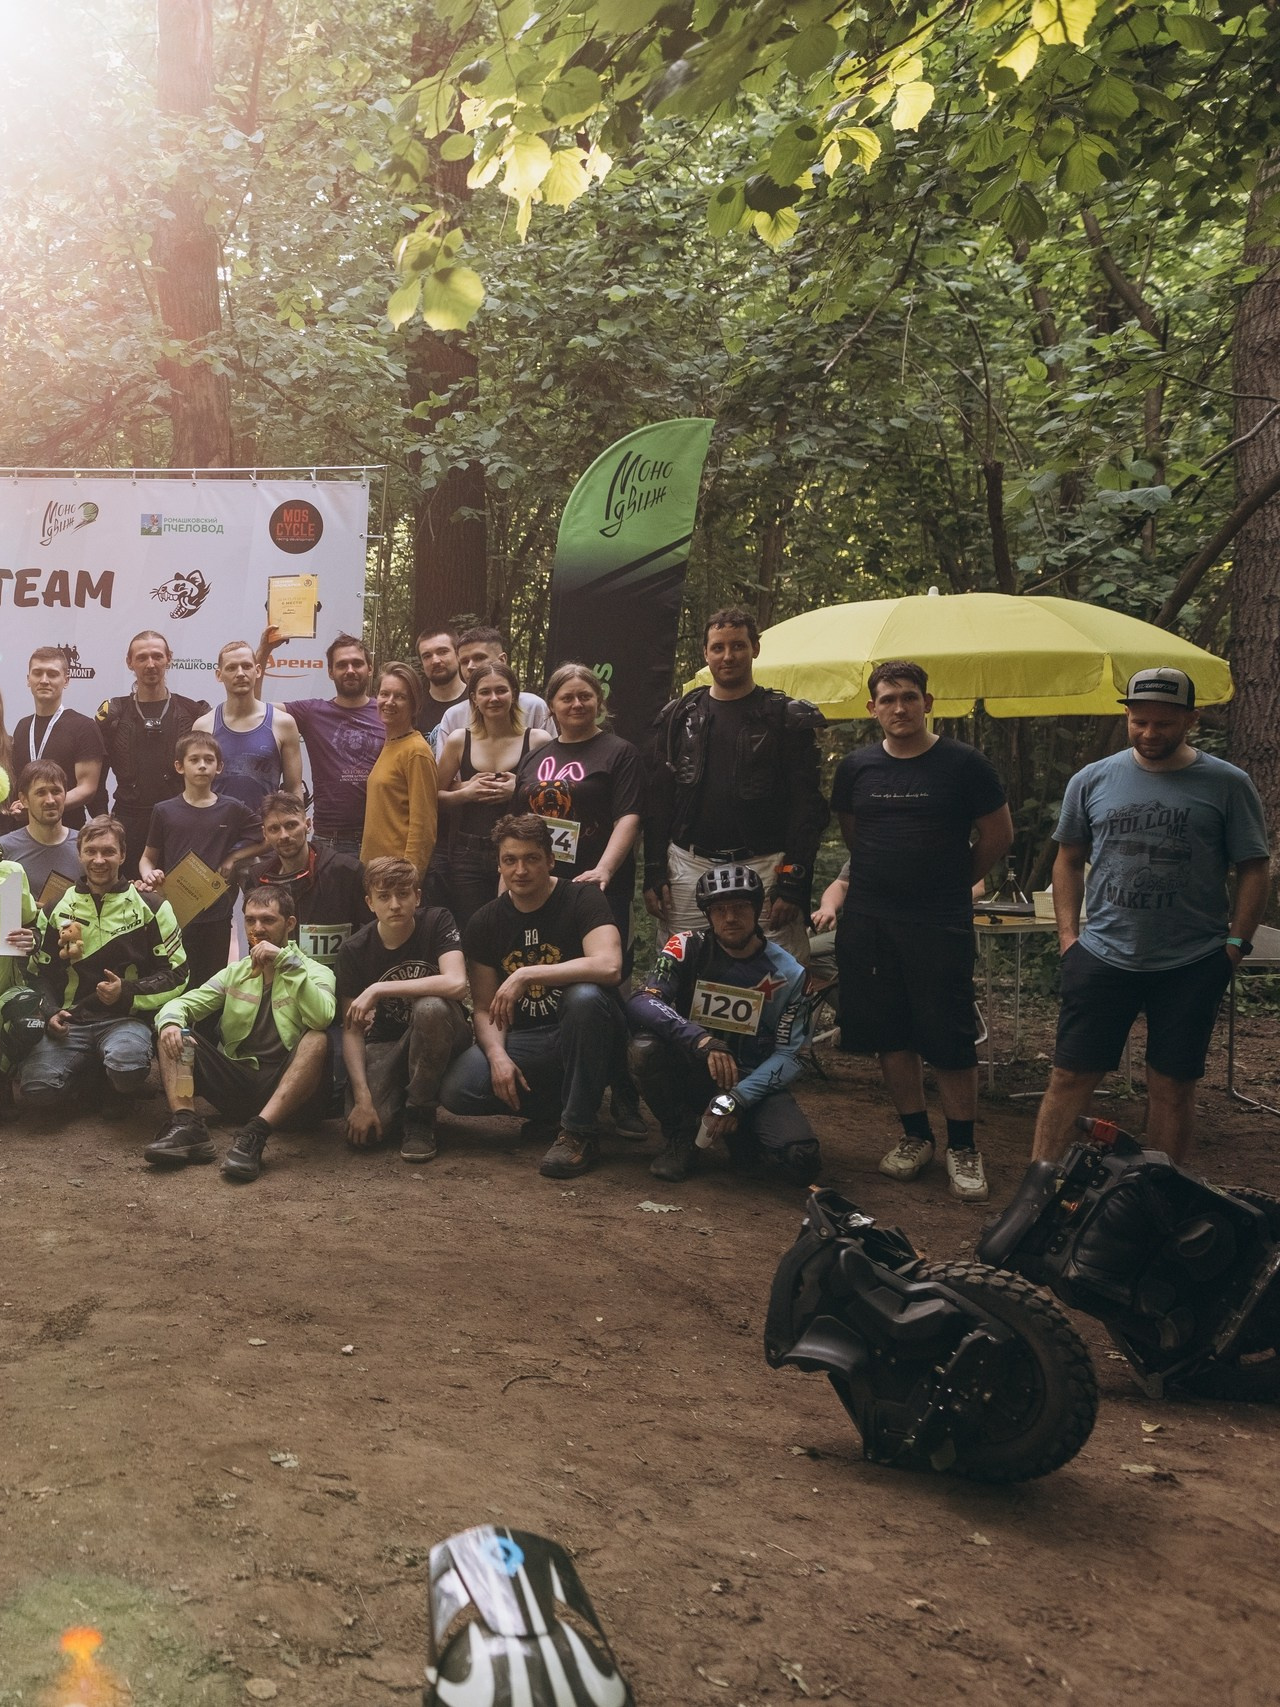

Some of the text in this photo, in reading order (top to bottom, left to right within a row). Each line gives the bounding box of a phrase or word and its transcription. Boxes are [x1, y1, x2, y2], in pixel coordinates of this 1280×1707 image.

[283, 509, 309, 522] MOS
[163, 523, 224, 534] ПЧЕЛОВОД
[276, 523, 315, 536] CYCLE
[265, 655, 324, 669] Арена
[1108, 807, 1191, 836] FOLLOW
[309, 934, 343, 955] 112
[701, 992, 753, 1023] 120
[776, 1002, 800, 1045] YAMAHA
